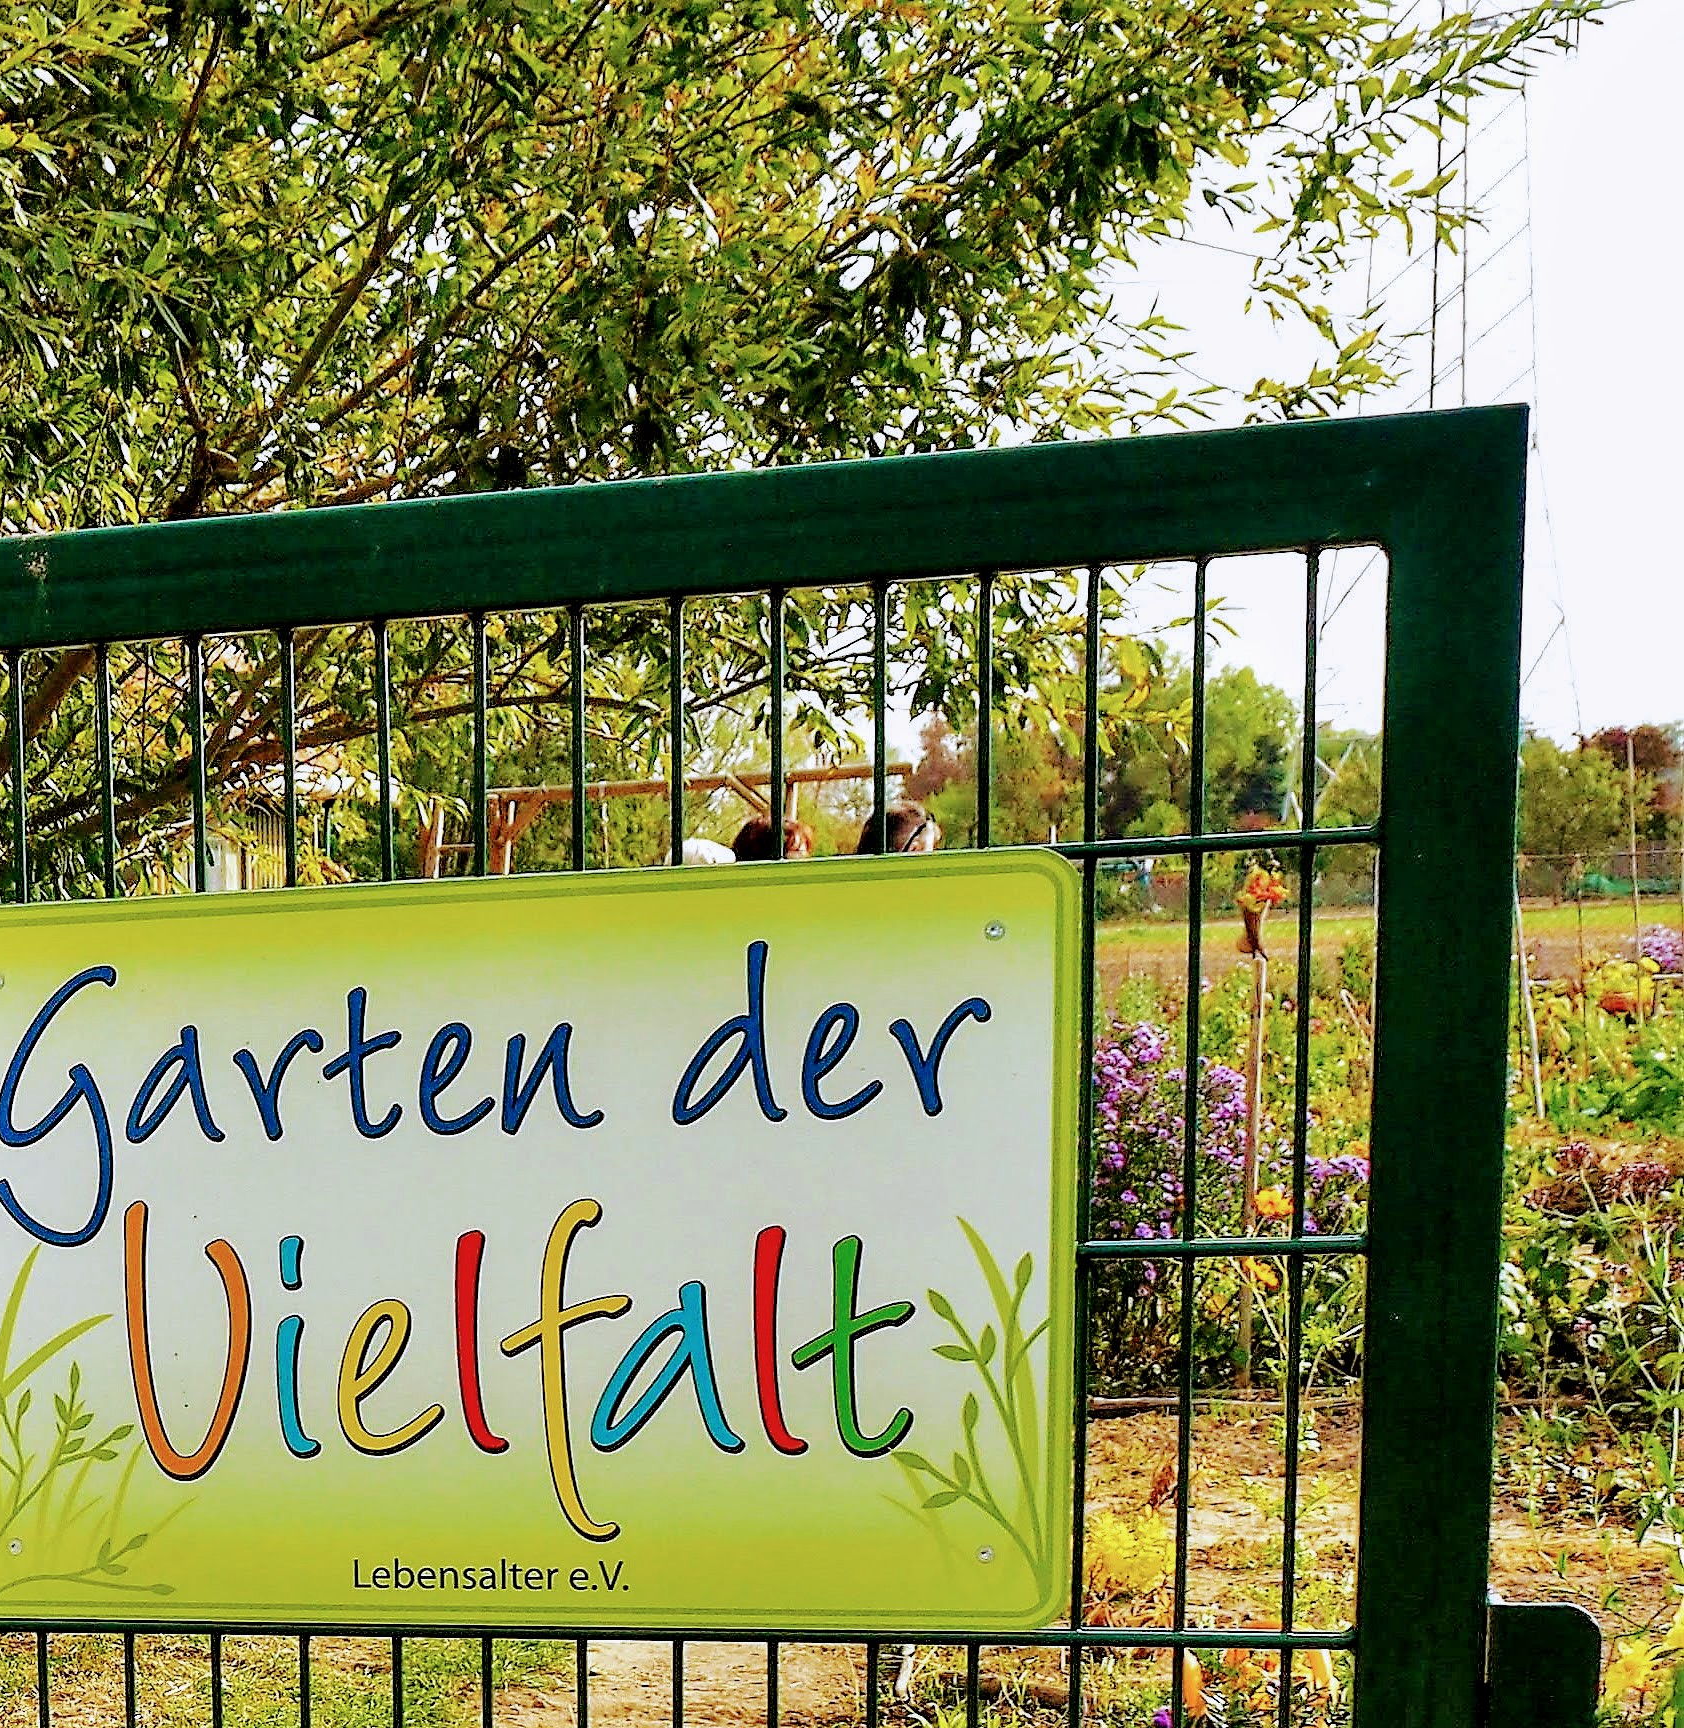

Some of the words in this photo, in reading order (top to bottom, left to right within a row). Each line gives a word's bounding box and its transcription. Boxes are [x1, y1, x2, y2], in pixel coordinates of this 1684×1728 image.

[672, 940, 993, 1126] der
[123, 1198, 916, 1543] Vielfalt
[353, 1557, 560, 1591] Lebensalter
[569, 1560, 631, 1591] e.V.
